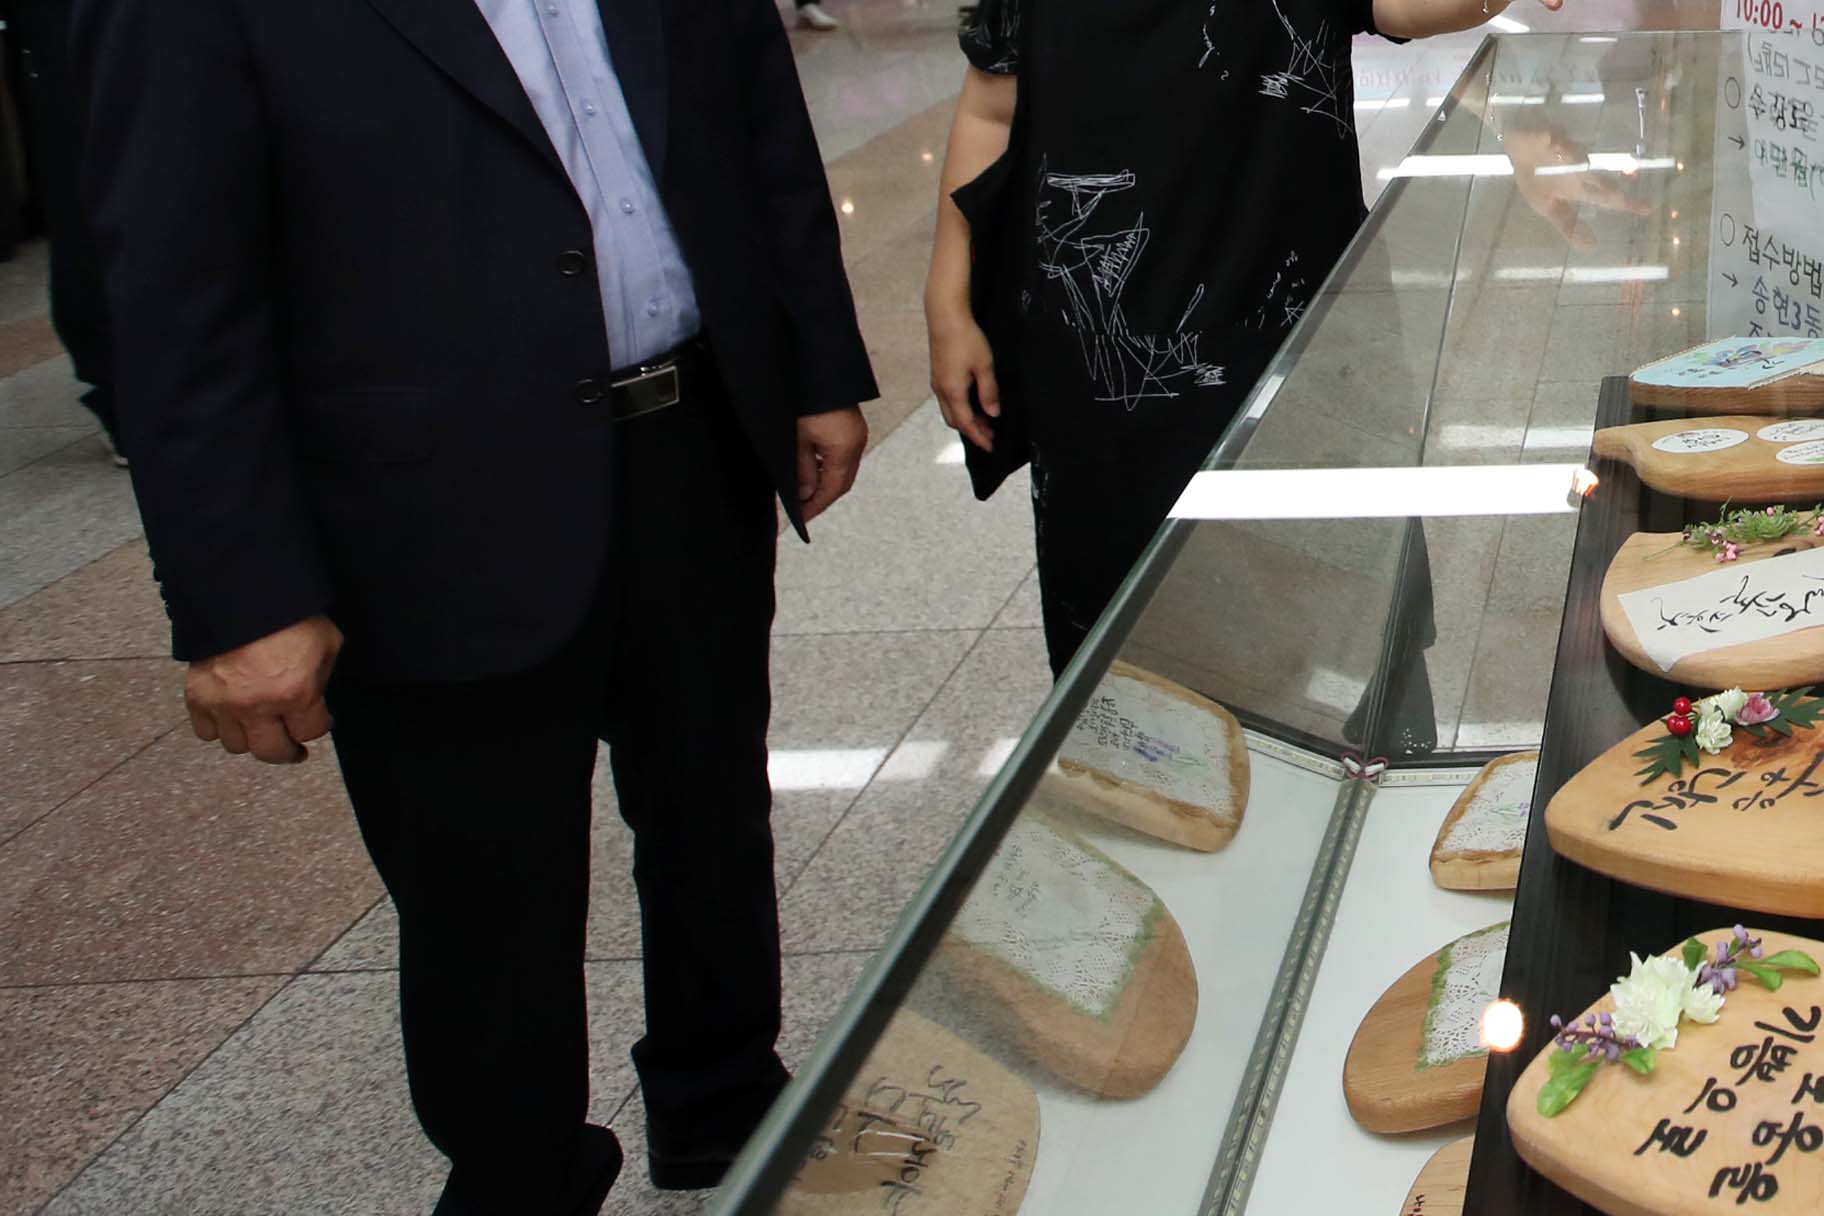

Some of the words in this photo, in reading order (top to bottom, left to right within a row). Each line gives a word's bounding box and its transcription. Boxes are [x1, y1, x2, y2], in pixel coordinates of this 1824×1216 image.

[1742, 224, 1823, 299] 접수방법
[1751, 274, 1823, 337] 송현3동
[1634, 1005, 1823, 1158] 기쁨으로
